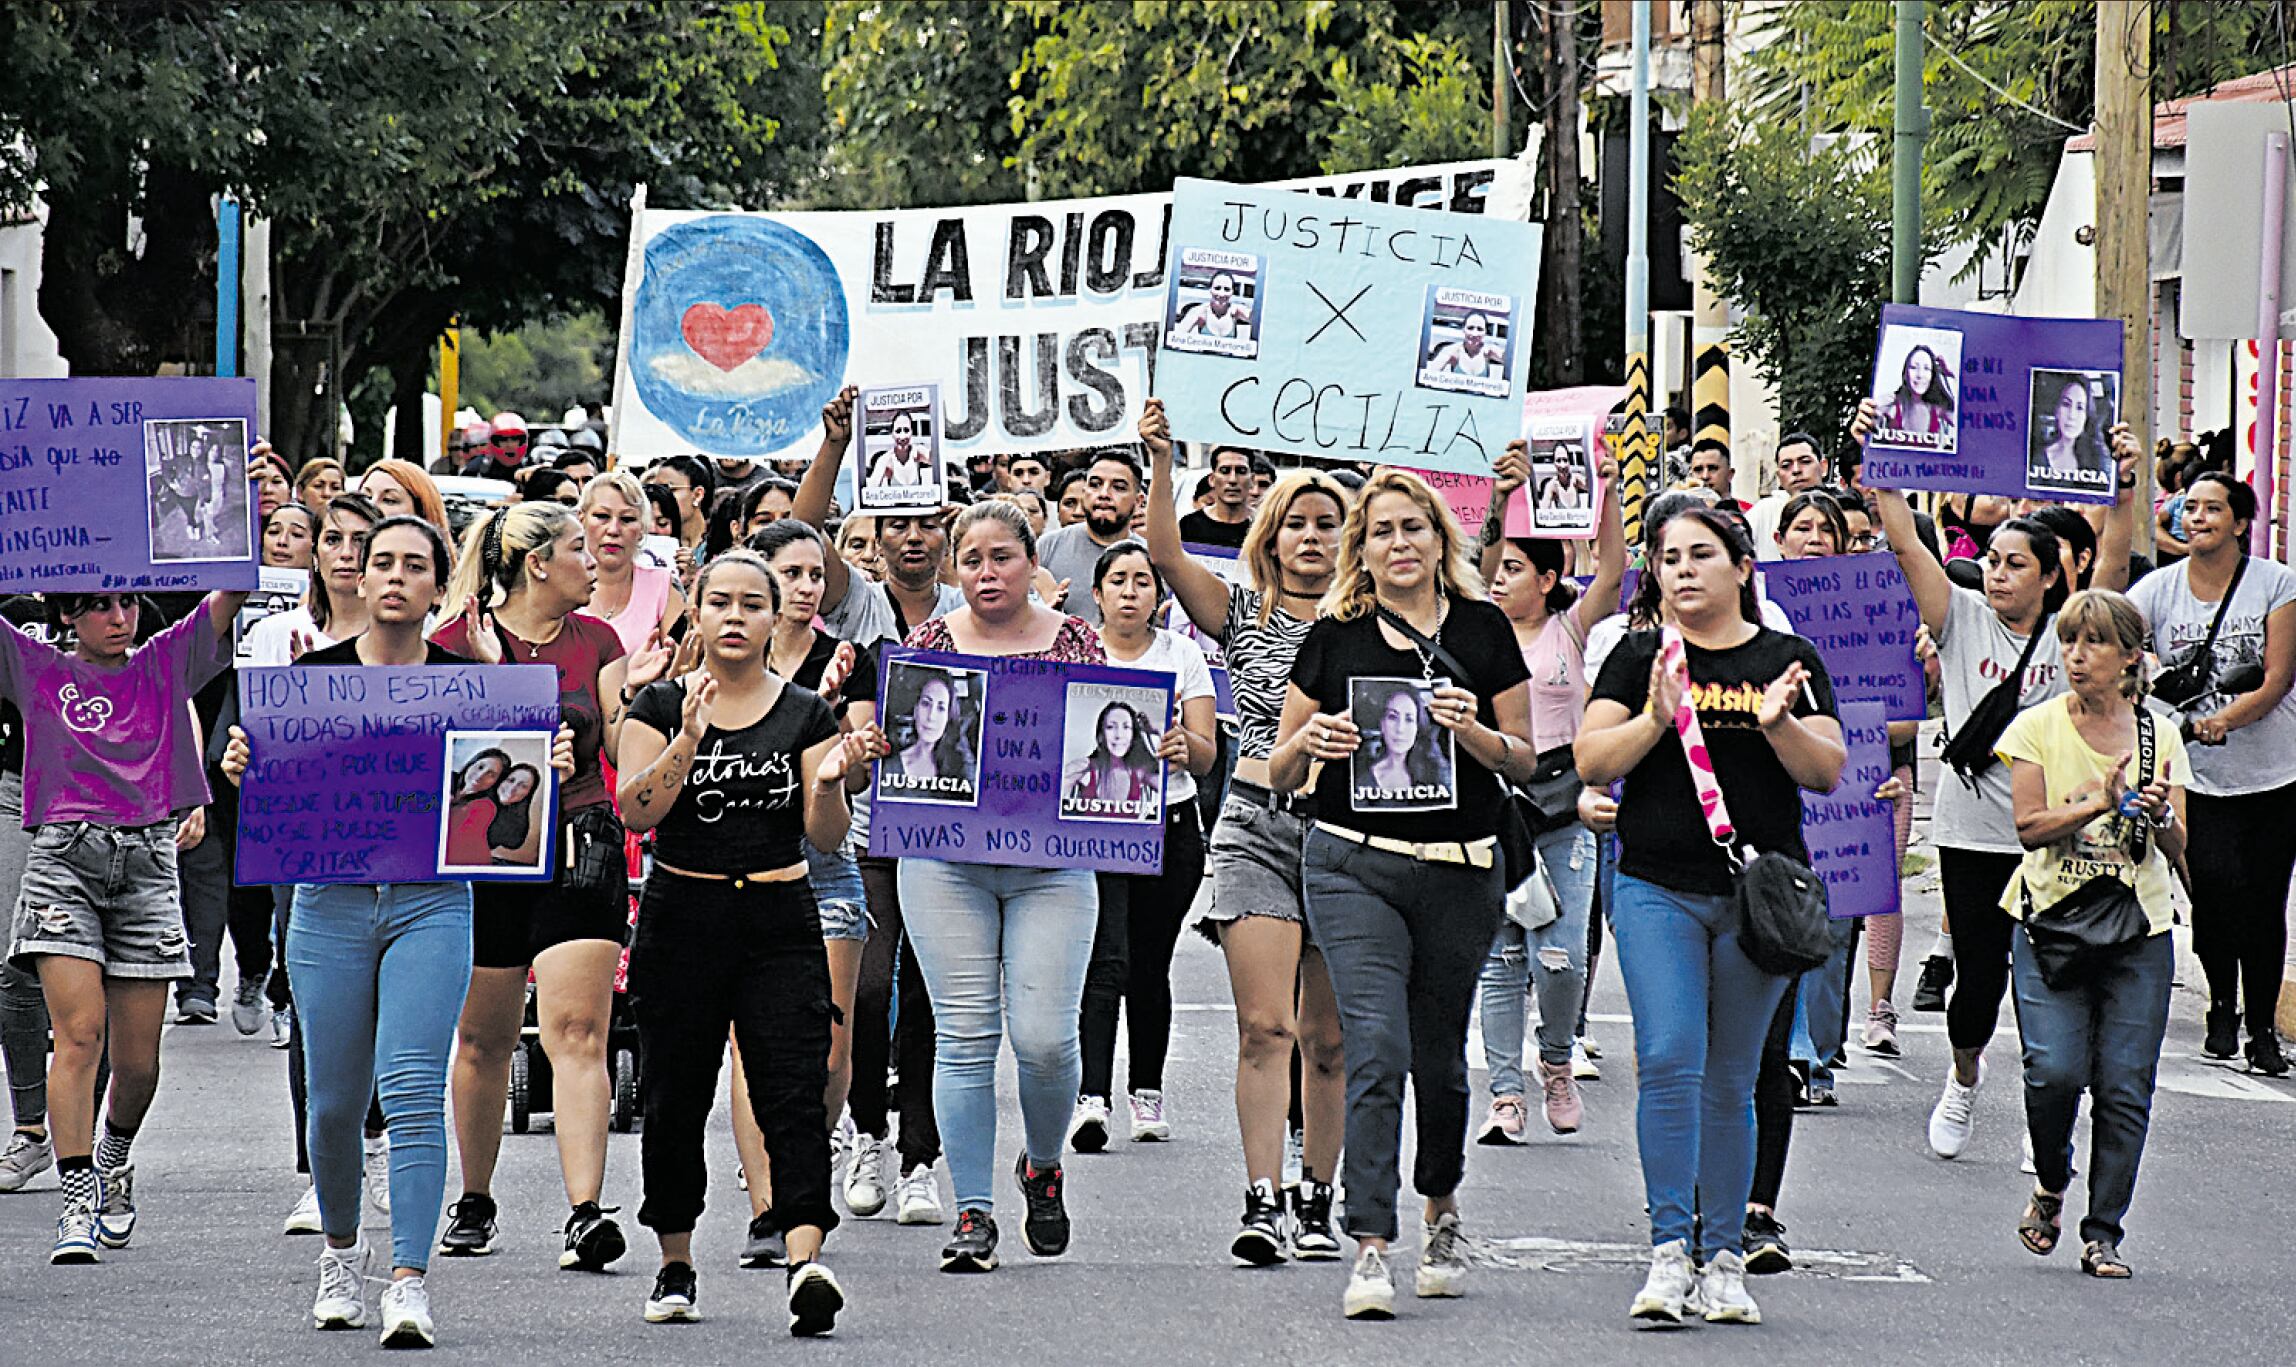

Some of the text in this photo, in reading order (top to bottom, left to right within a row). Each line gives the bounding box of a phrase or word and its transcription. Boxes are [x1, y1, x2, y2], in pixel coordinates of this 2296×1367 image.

[1221, 201, 1484, 269] JUSTICIA
[870, 218, 974, 303] LA
[1005, 203, 1174, 300] RIOJ
[1189, 252, 1249, 267] JUSTICIA POR
[1442, 292, 1503, 306] JUSTICIA POR
[1304, 279, 1374, 345] X
[944, 321, 1161, 440] JUST
[871, 392, 923, 406] JUSTICIA POR
[1963, 386, 1998, 403] UNA
[48, 402, 74, 429] VA
[89, 401, 103, 427] A
[110, 401, 143, 425] SER
[688, 405, 725, 434] La
[1960, 410, 2018, 432] MENOS
[1873, 426, 1955, 447] JUSTICIA
[2028, 465, 2111, 485] JUSTICIA
[1784, 571, 1841, 597] SOMOS
[1822, 602, 1852, 621] LAS
[247, 668, 488, 708] HOY NO ESTÁN
[1858, 673, 1908, 688] MENOS
[1071, 685, 1164, 705] JUSTICIA
[259, 714, 357, 743] TODAS
[996, 739, 1041, 760] UNA
[880, 772, 973, 795] JUSTICIA
[983, 770, 1052, 793] MENOS
[1856, 765, 1883, 784] NO
[1354, 784, 1451, 801] JUSTICIA
[1063, 797, 1157, 818] JUSTICIA
[323, 820, 399, 842] PUEDE
[986, 830, 1032, 853] NOS
[1045, 834, 1161, 870] QUEREMOS!
[1816, 866, 1861, 884] ENOS
[2060, 857, 2125, 880] RUSTY
